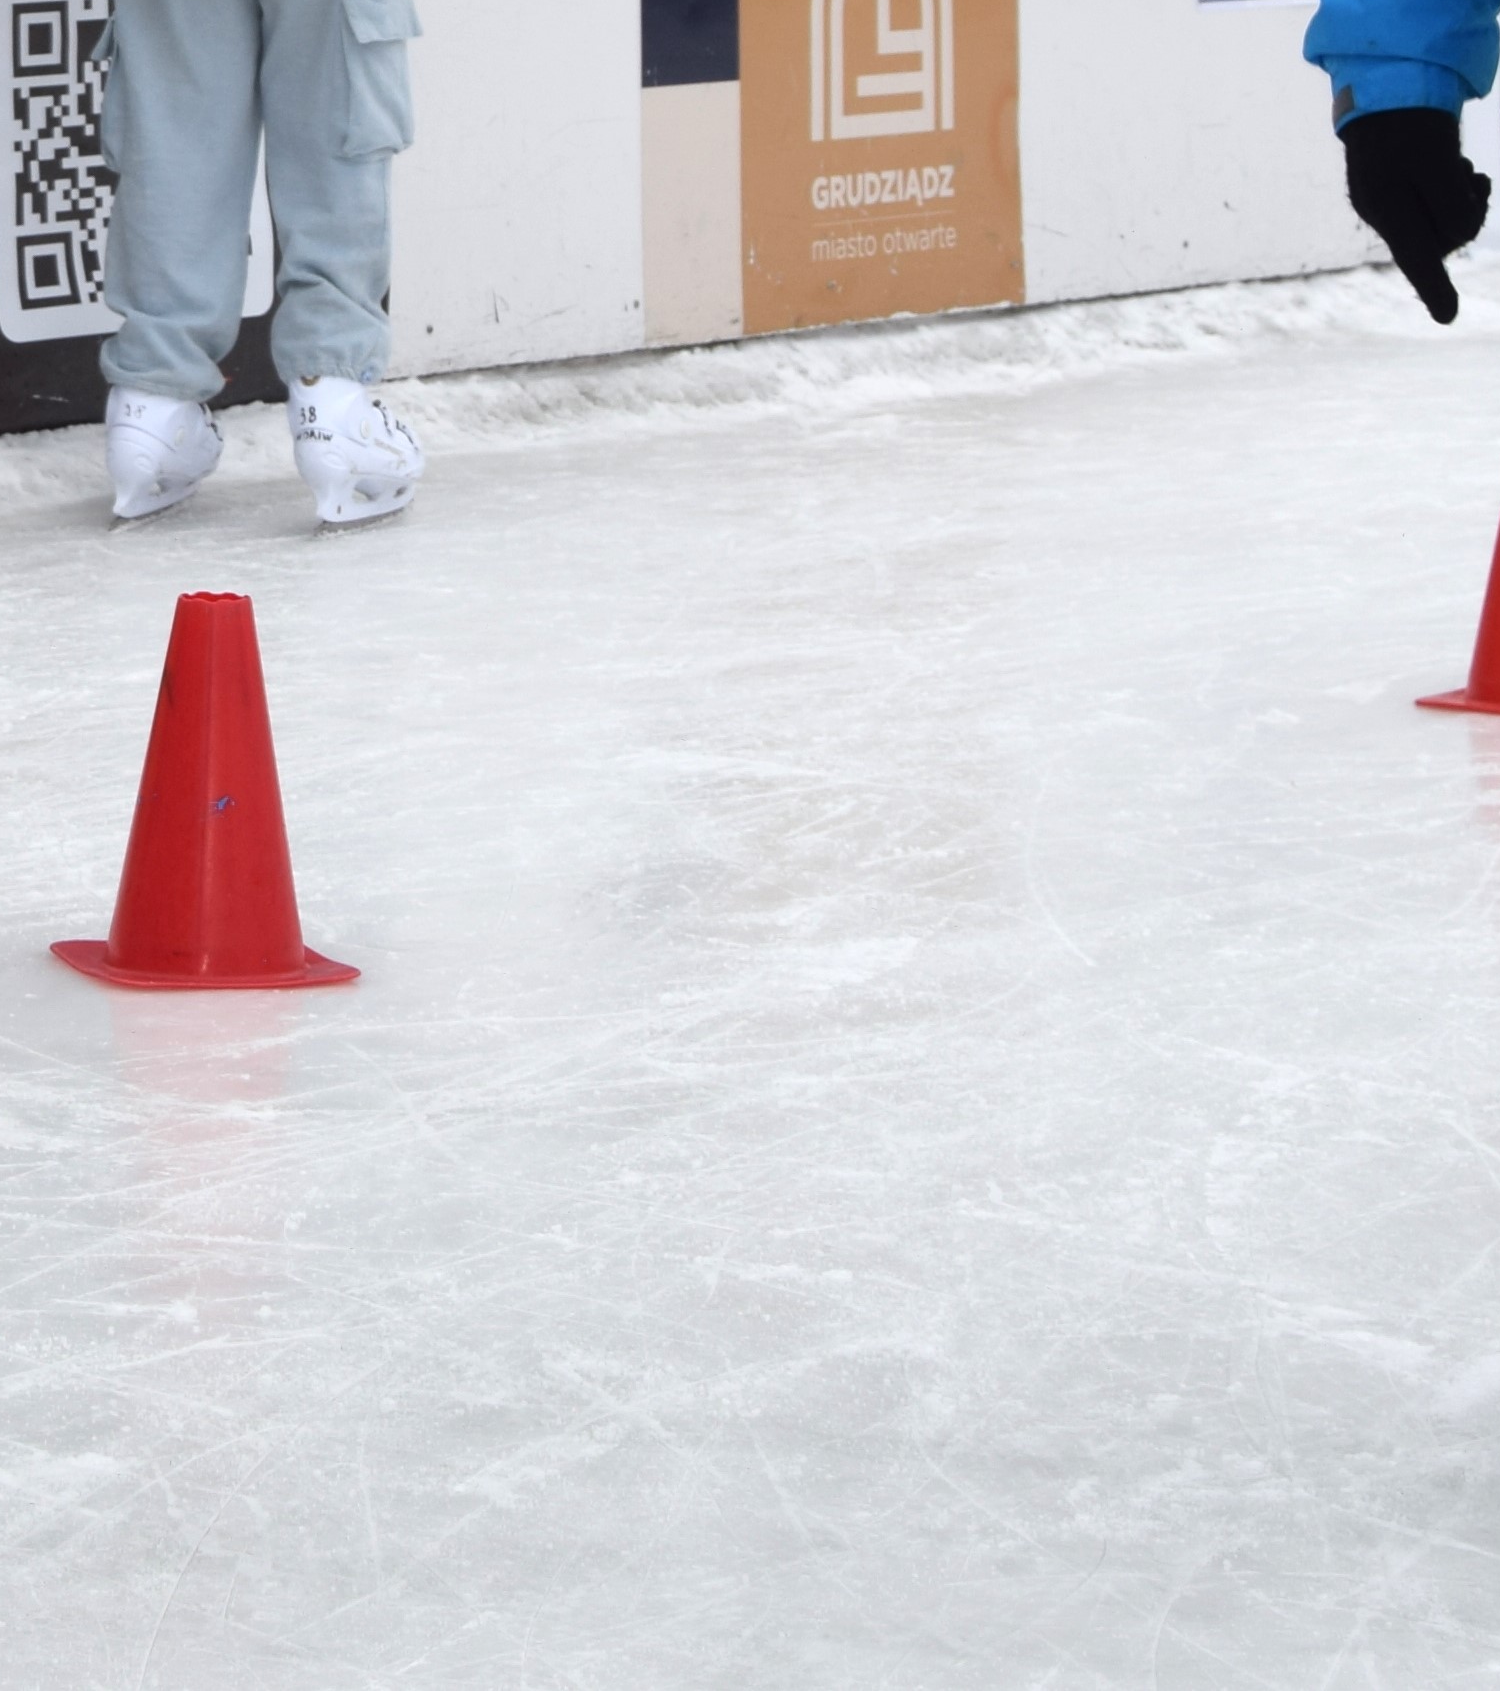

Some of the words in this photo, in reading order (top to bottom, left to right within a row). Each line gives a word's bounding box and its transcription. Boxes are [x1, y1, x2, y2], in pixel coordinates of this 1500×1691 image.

[811, 164, 956, 210] GRUDZIĄDZ
[811, 230, 878, 261] miasto
[883, 224, 958, 255] otwarte
